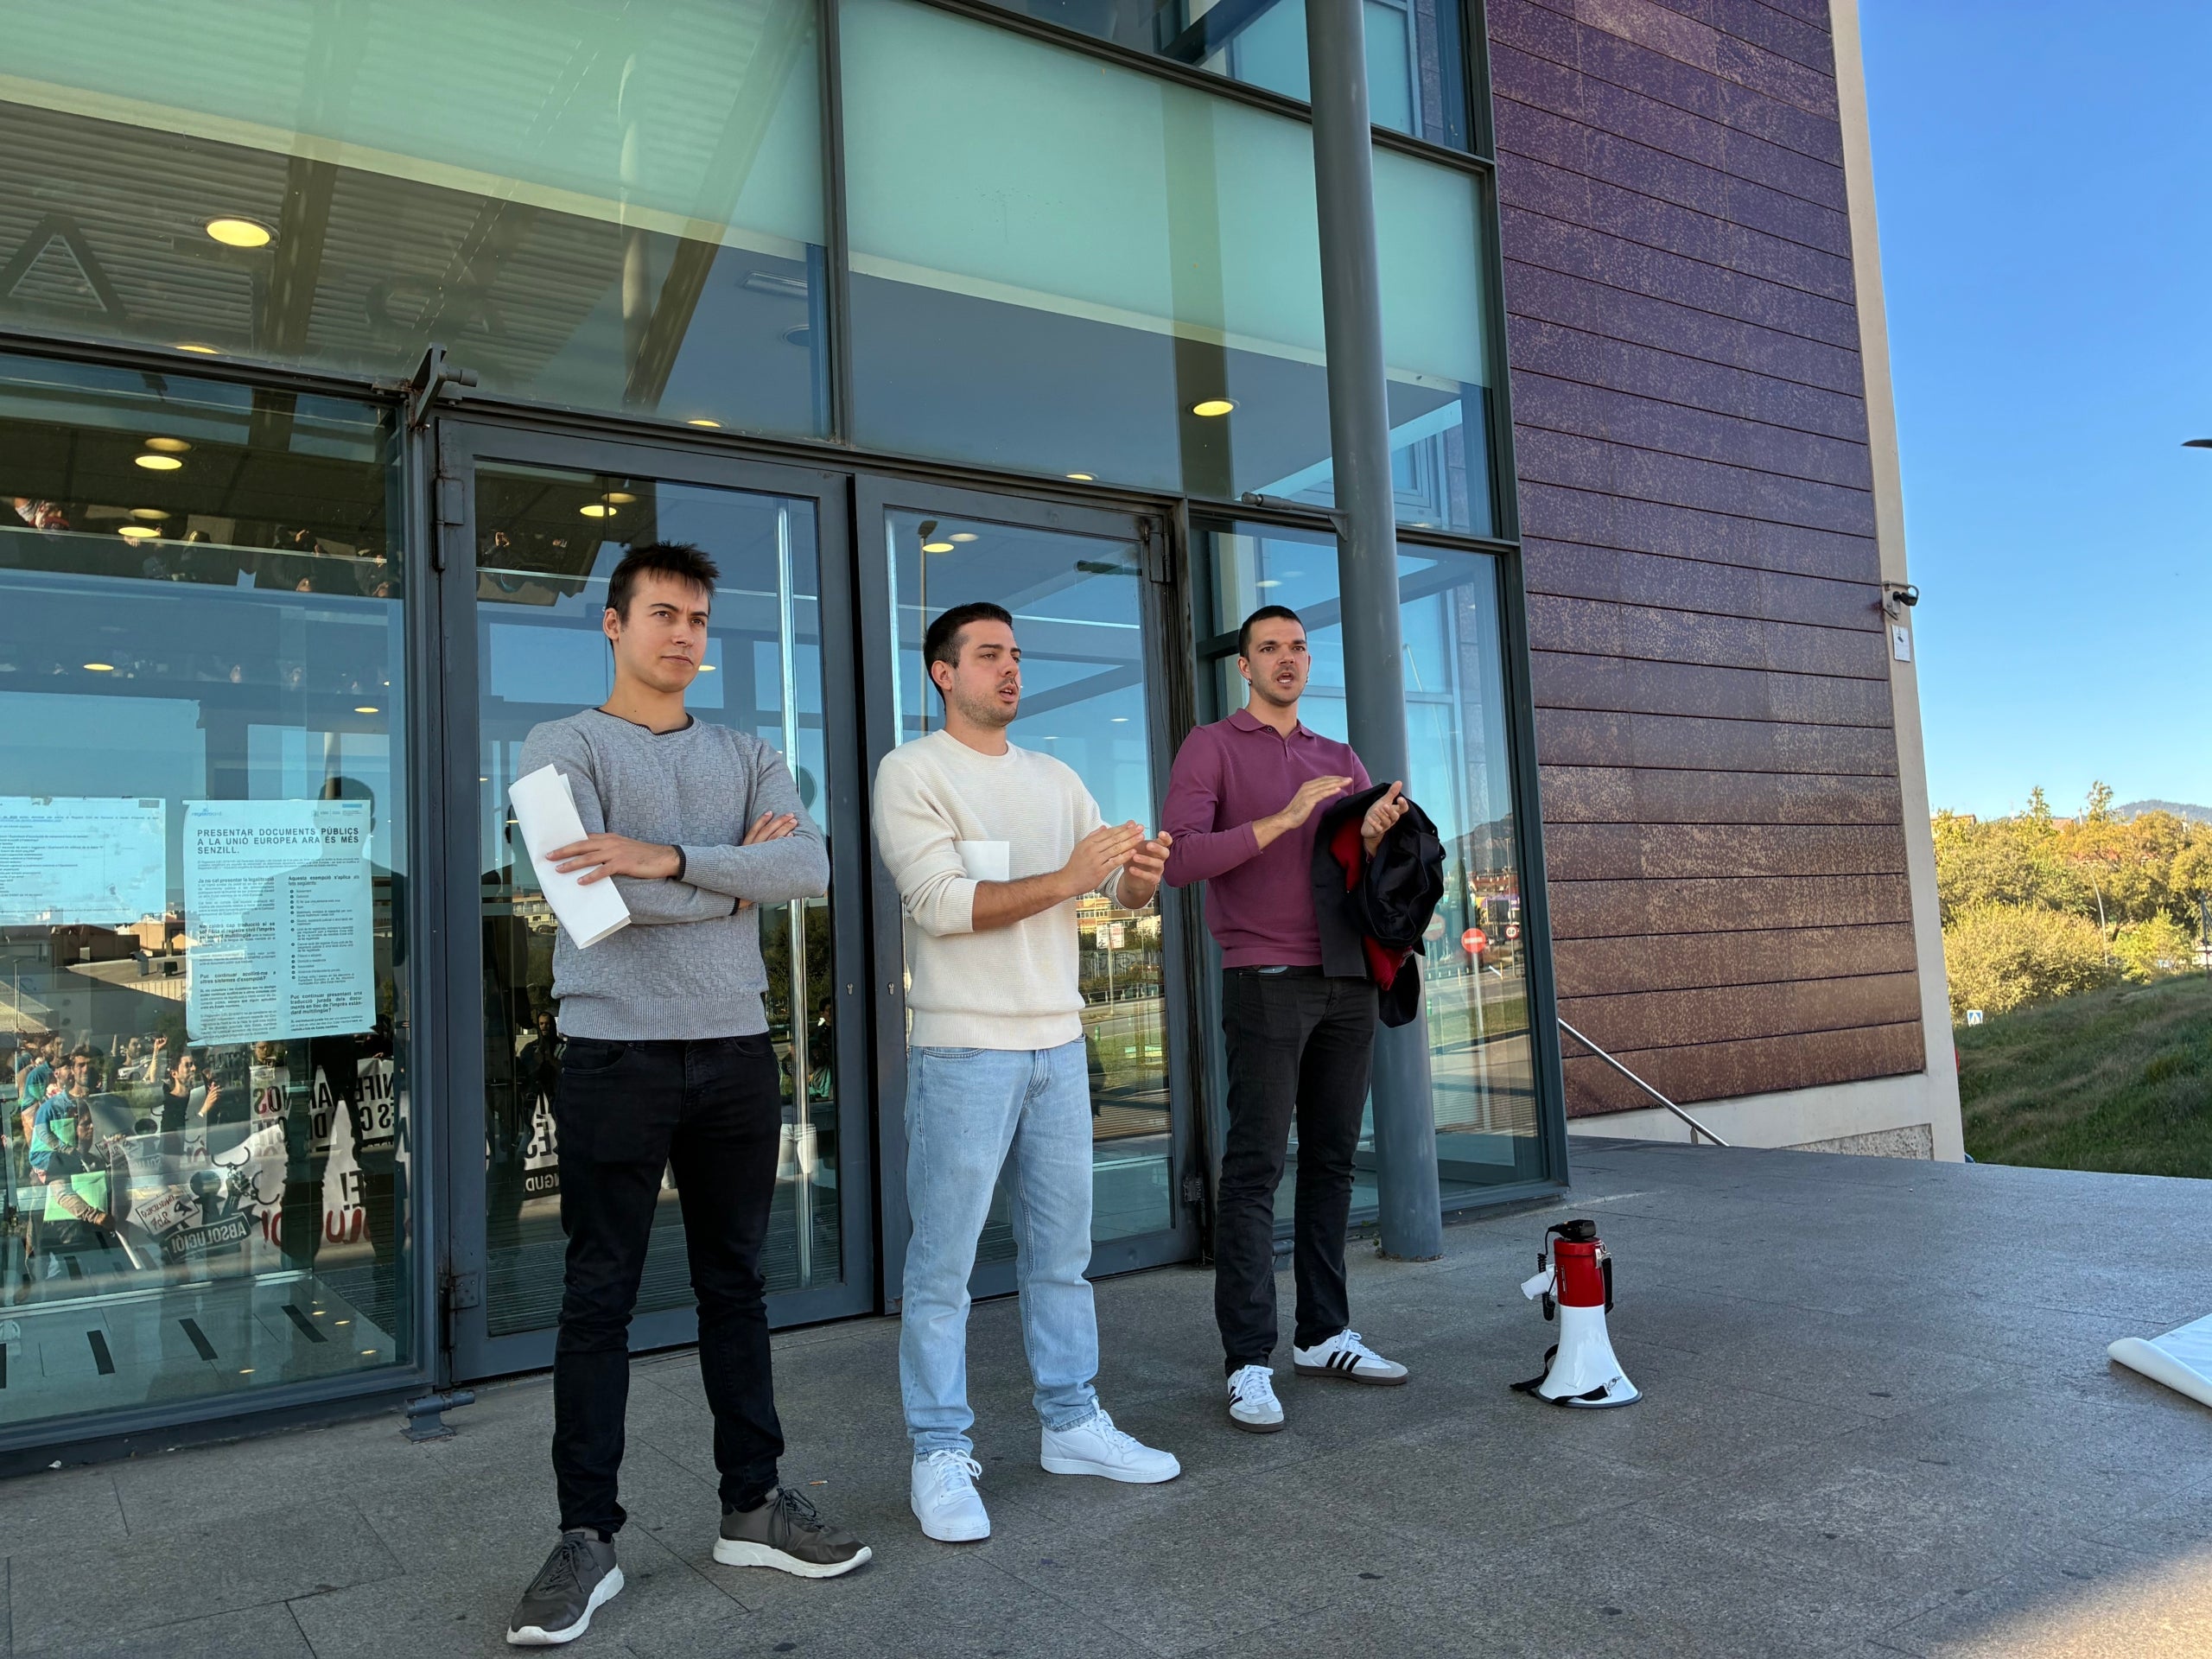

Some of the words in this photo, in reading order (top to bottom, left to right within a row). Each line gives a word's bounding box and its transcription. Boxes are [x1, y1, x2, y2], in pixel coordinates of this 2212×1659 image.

[321, 826, 359, 835] PÚBLICS
[226, 836, 249, 845] UNIÓ
[325, 835, 336, 843] ÉS
[340, 835, 359, 843] MÉS
